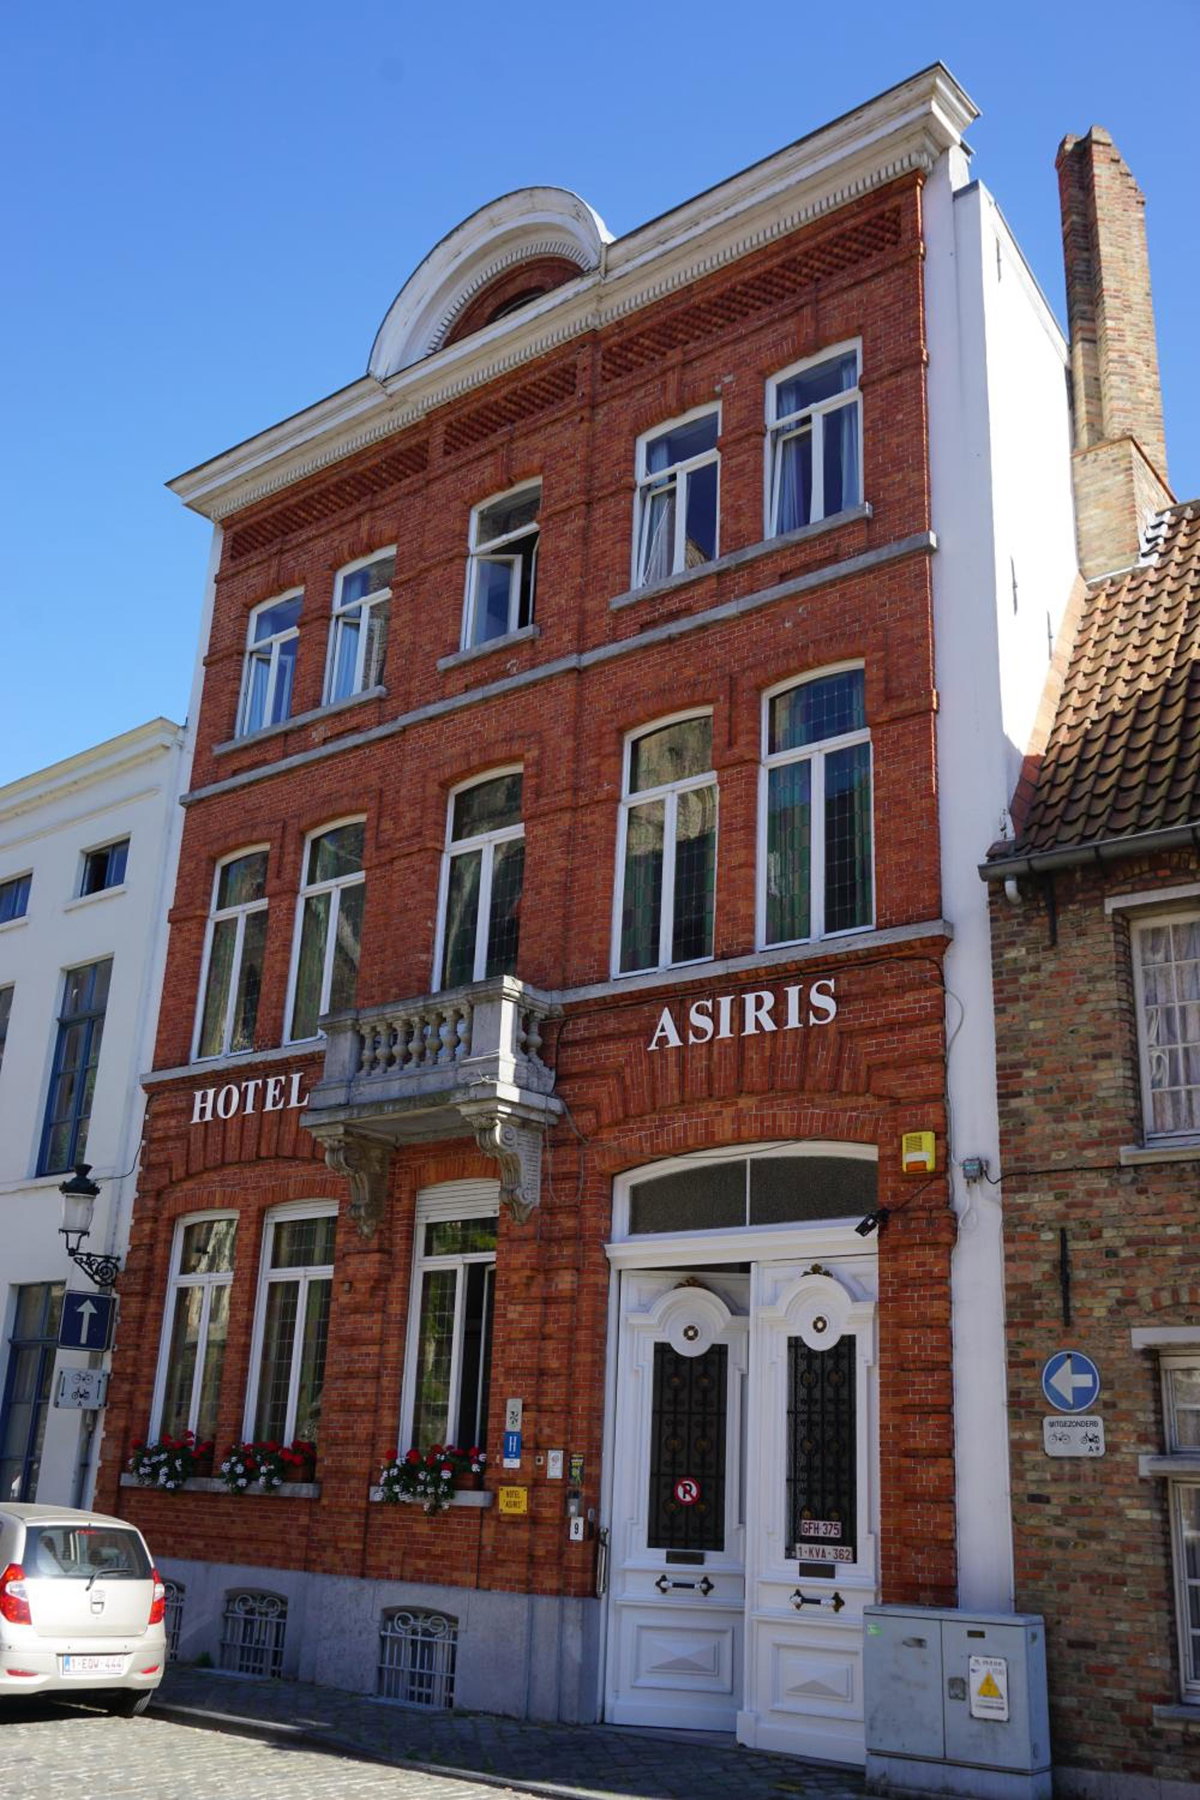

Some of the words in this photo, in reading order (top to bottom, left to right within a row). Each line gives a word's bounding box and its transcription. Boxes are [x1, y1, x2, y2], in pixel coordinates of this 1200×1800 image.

[647, 979, 837, 1051] ASIRIS
[190, 1072, 309, 1124] HOTEL
[574, 1522, 579, 1535] 9
